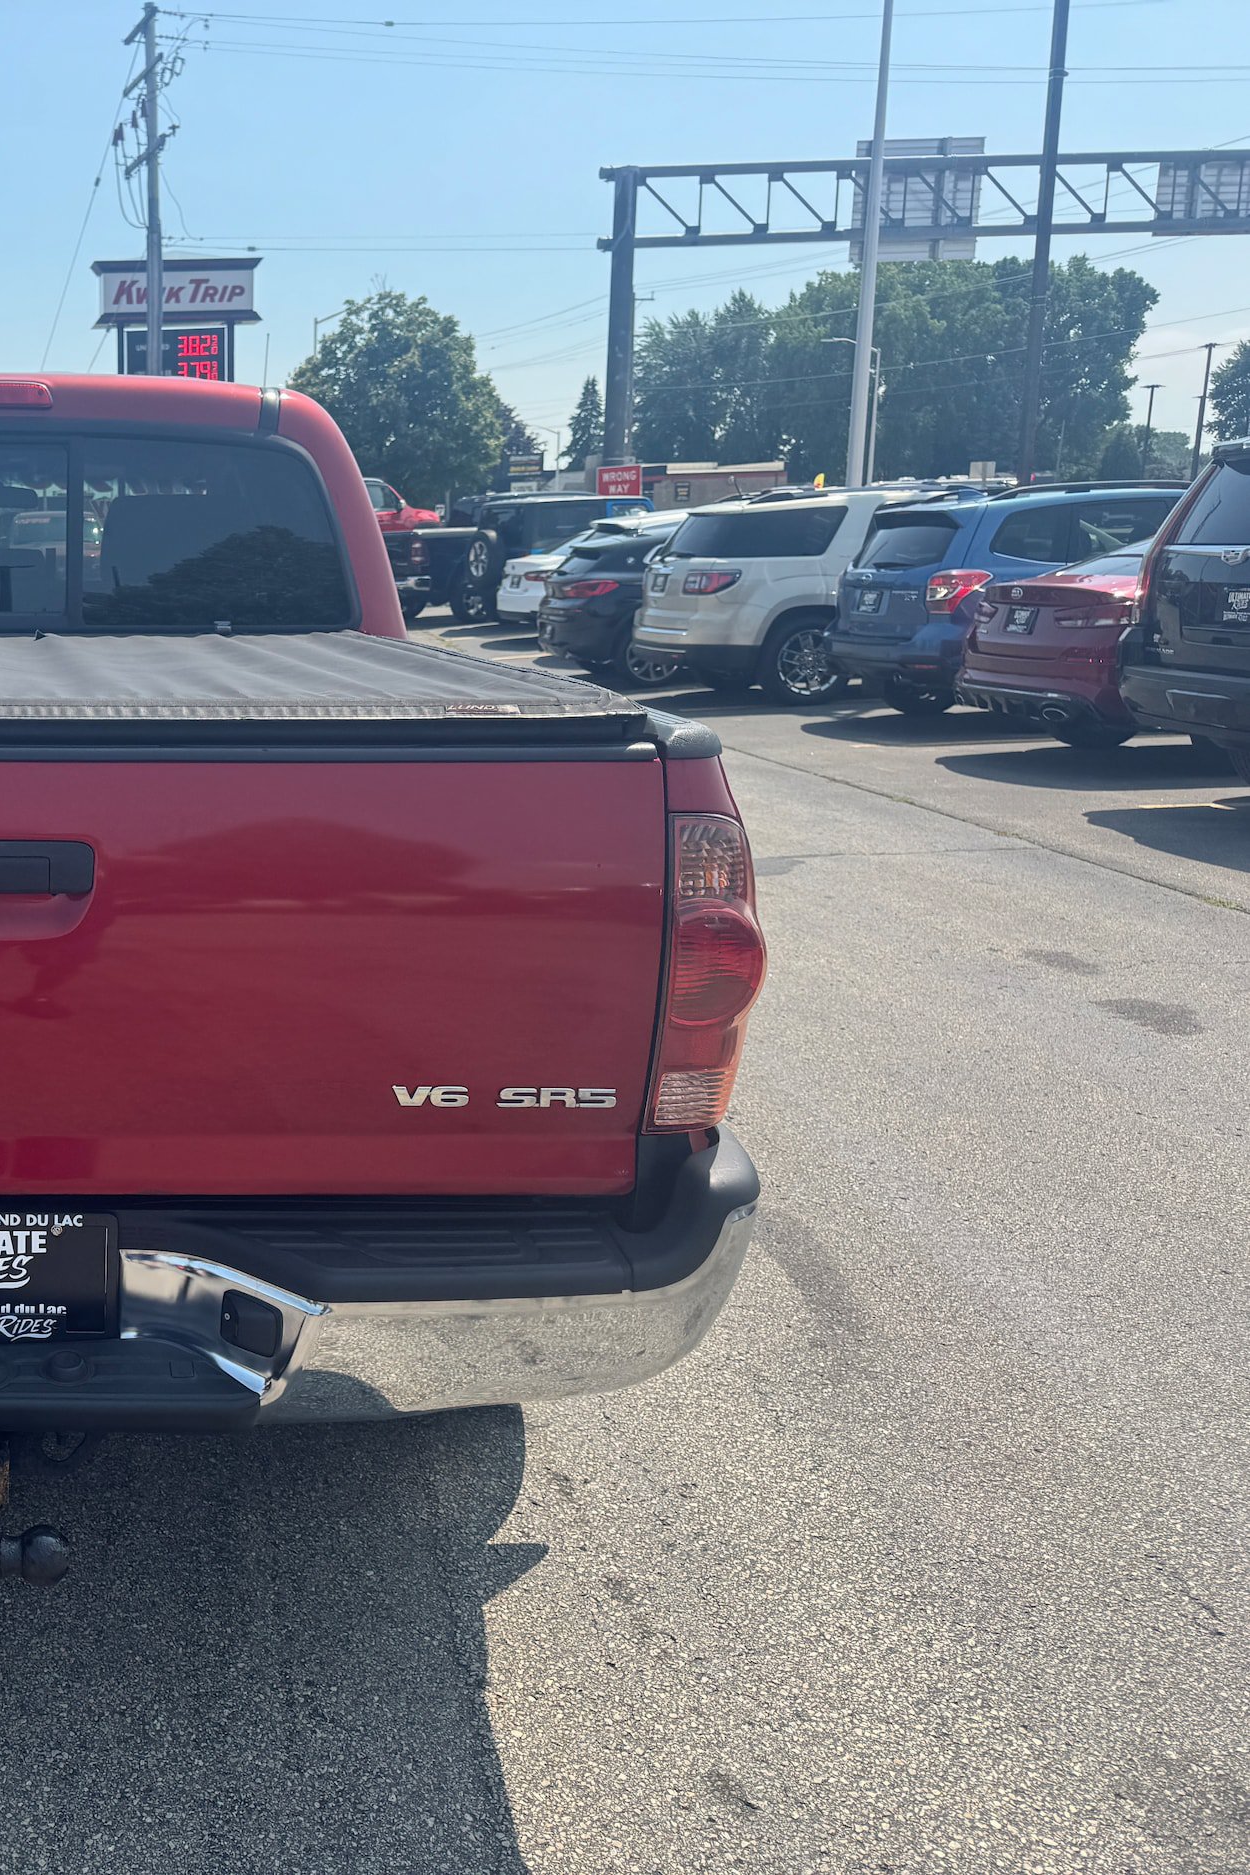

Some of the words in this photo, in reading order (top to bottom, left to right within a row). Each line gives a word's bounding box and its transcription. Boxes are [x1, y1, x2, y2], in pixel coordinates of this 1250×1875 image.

[112, 280, 186, 305] KWK
[188, 278, 245, 303] TRIP
[602, 470, 637, 482] WRONG
[608, 484, 630, 494] WAY
[392, 1085, 469, 1108] V6
[496, 1087, 617, 1108] SR5
[26, 1214, 49, 1227] DU
[53, 1214, 84, 1227] LAC
